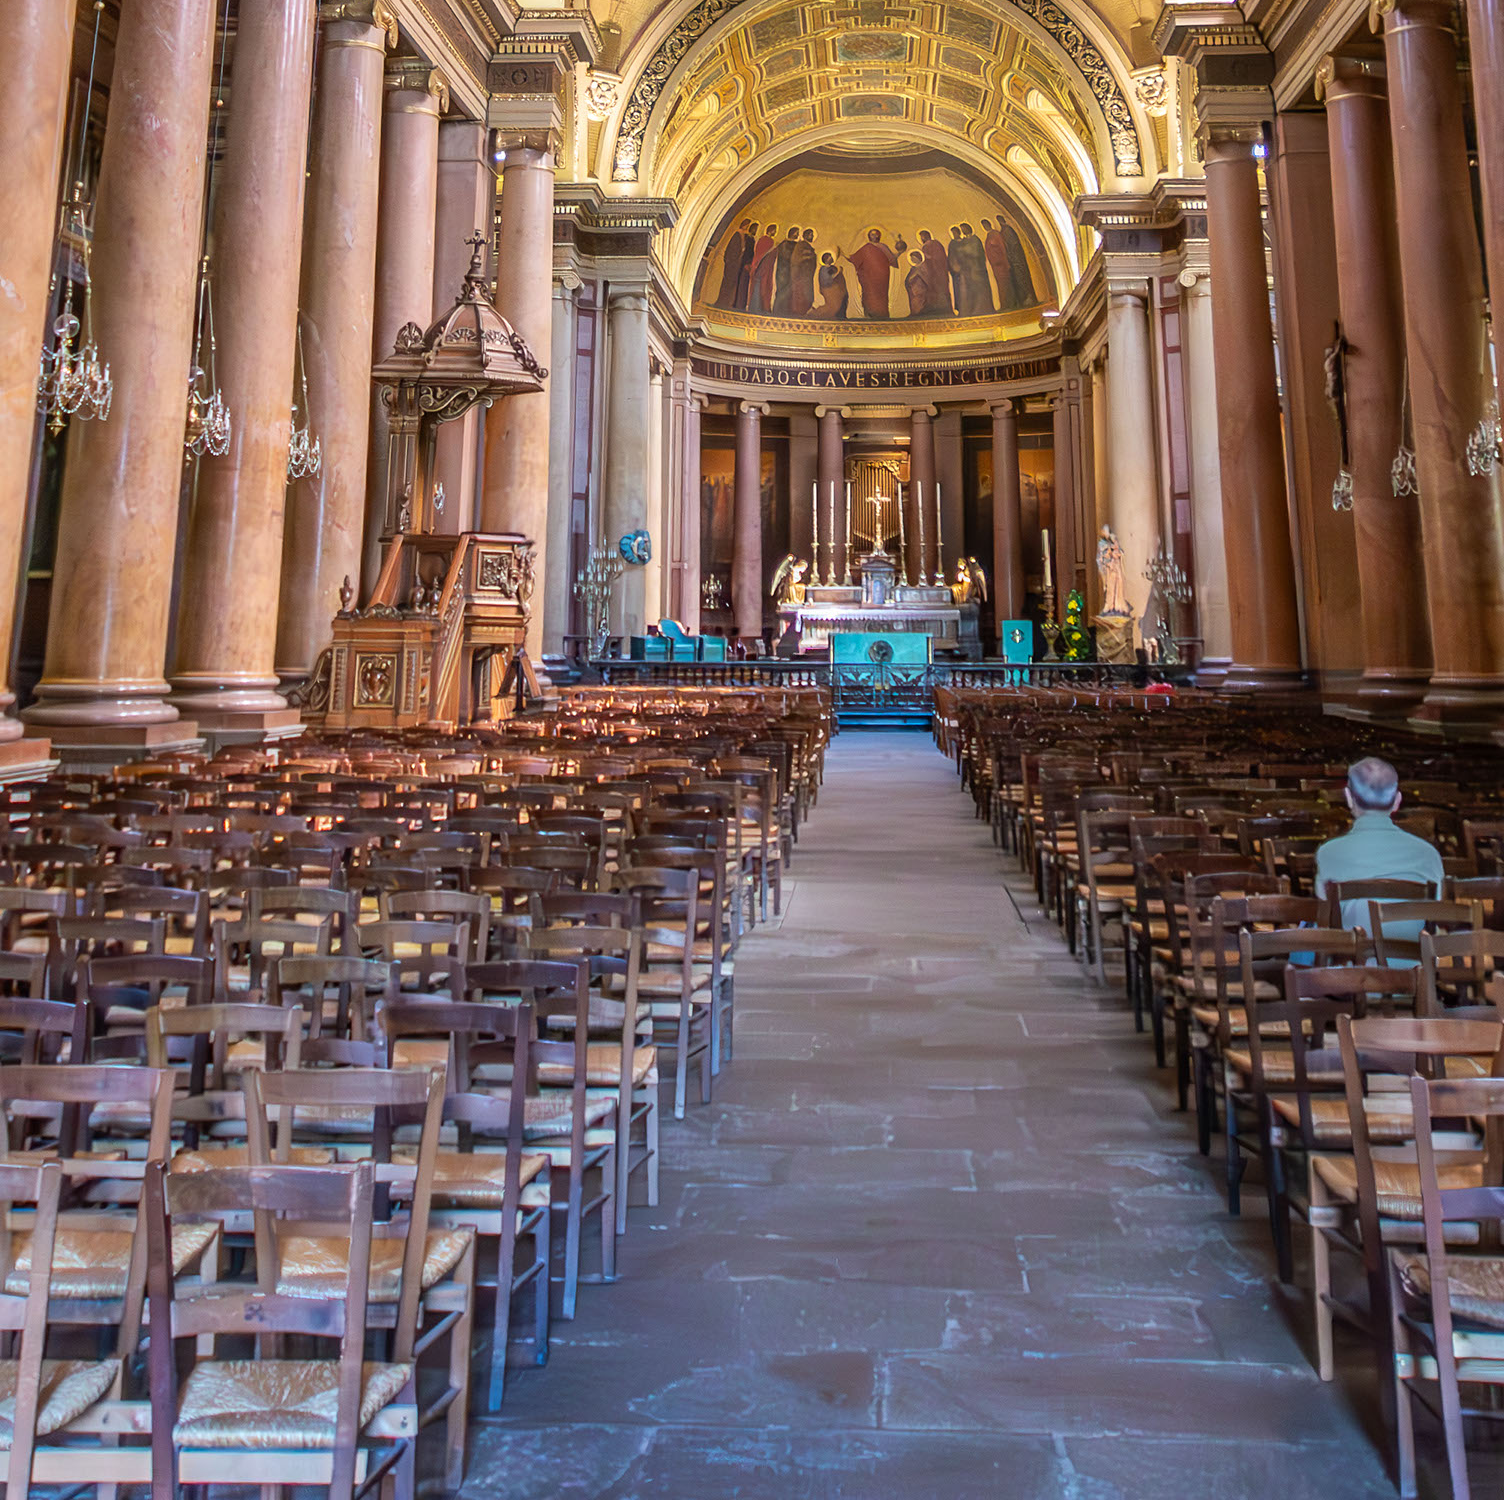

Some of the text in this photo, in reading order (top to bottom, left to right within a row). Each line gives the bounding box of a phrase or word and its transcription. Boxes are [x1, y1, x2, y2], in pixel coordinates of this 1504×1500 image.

[739, 366, 790, 385] DABO
[797, 371, 880, 388] CLAVES
[889, 370, 953, 388] REGNI
